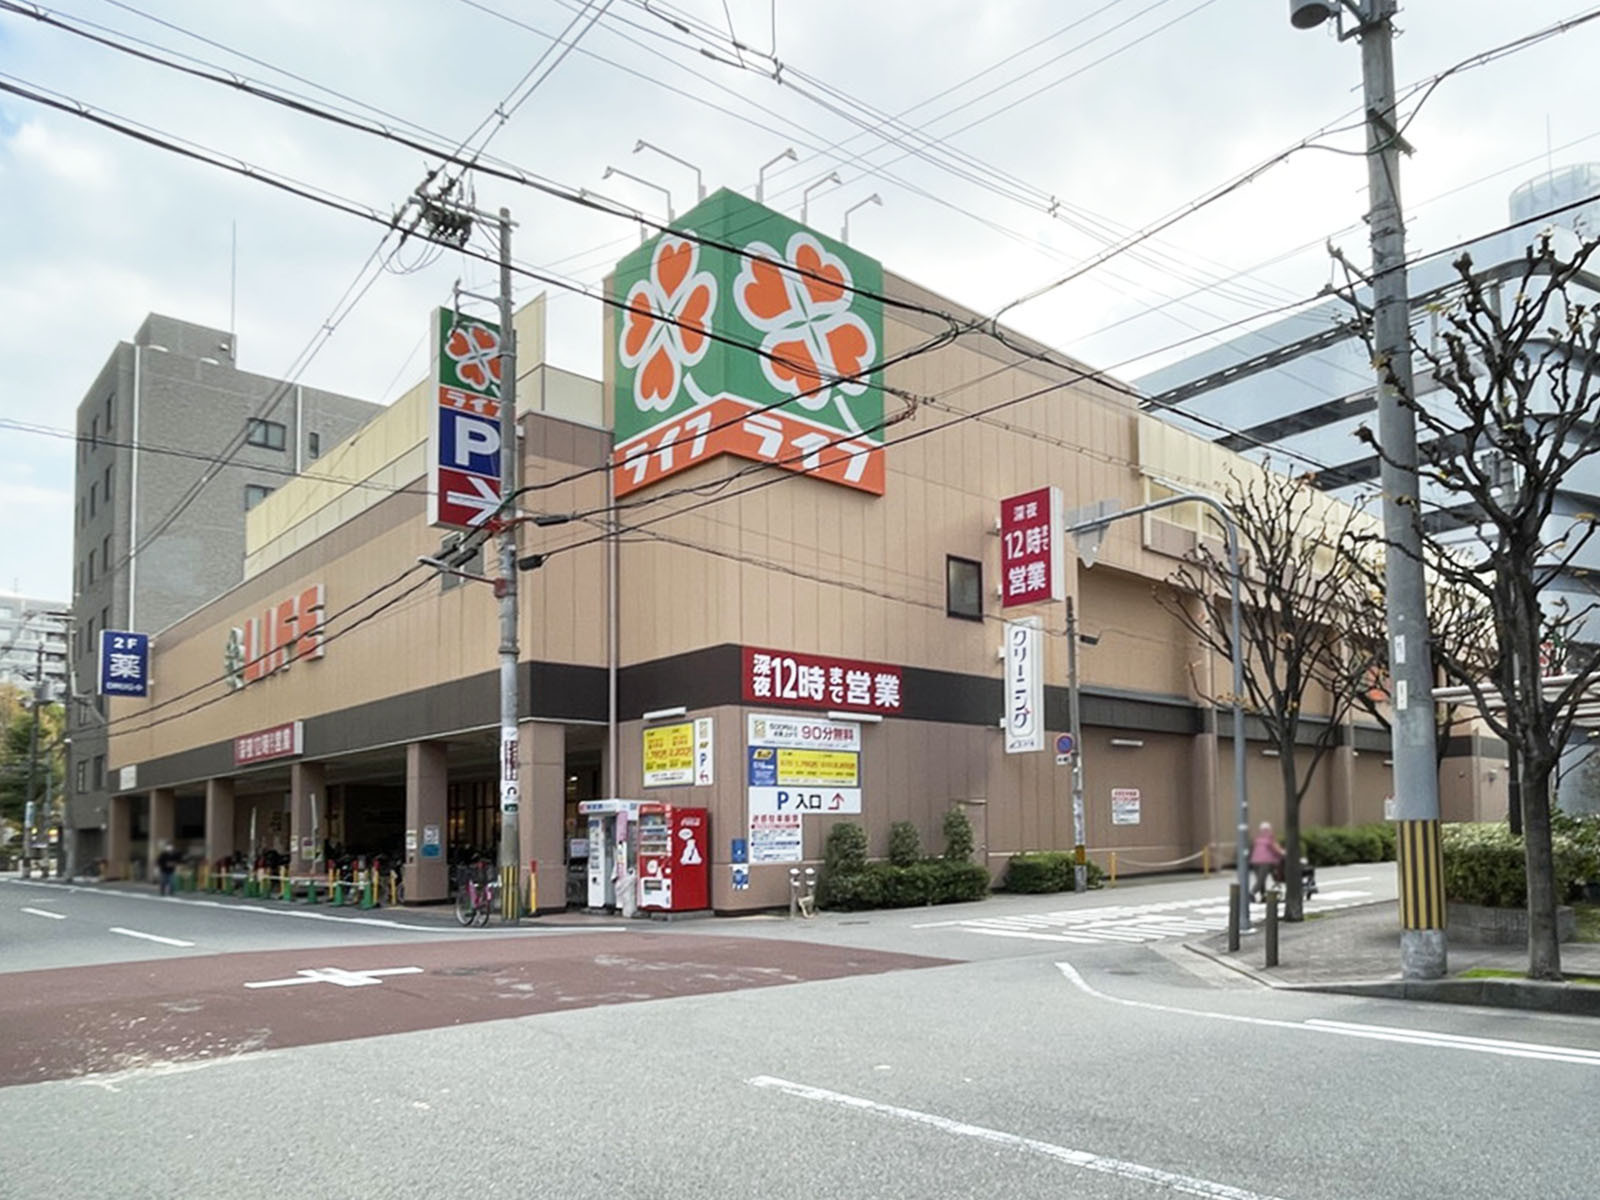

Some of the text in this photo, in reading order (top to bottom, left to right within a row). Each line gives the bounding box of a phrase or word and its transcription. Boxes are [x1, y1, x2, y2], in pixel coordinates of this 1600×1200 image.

[455, 415, 500, 467] P
[624, 411, 712, 485] ライフ
[742, 411, 870, 483] ライフ
[1009, 561, 1046, 596] 営業
[113, 637, 138, 649] 2F
[110, 653, 140, 678] 薬
[1013, 630, 1030, 728] クリーニング
[777, 791, 822, 810] P 入口
